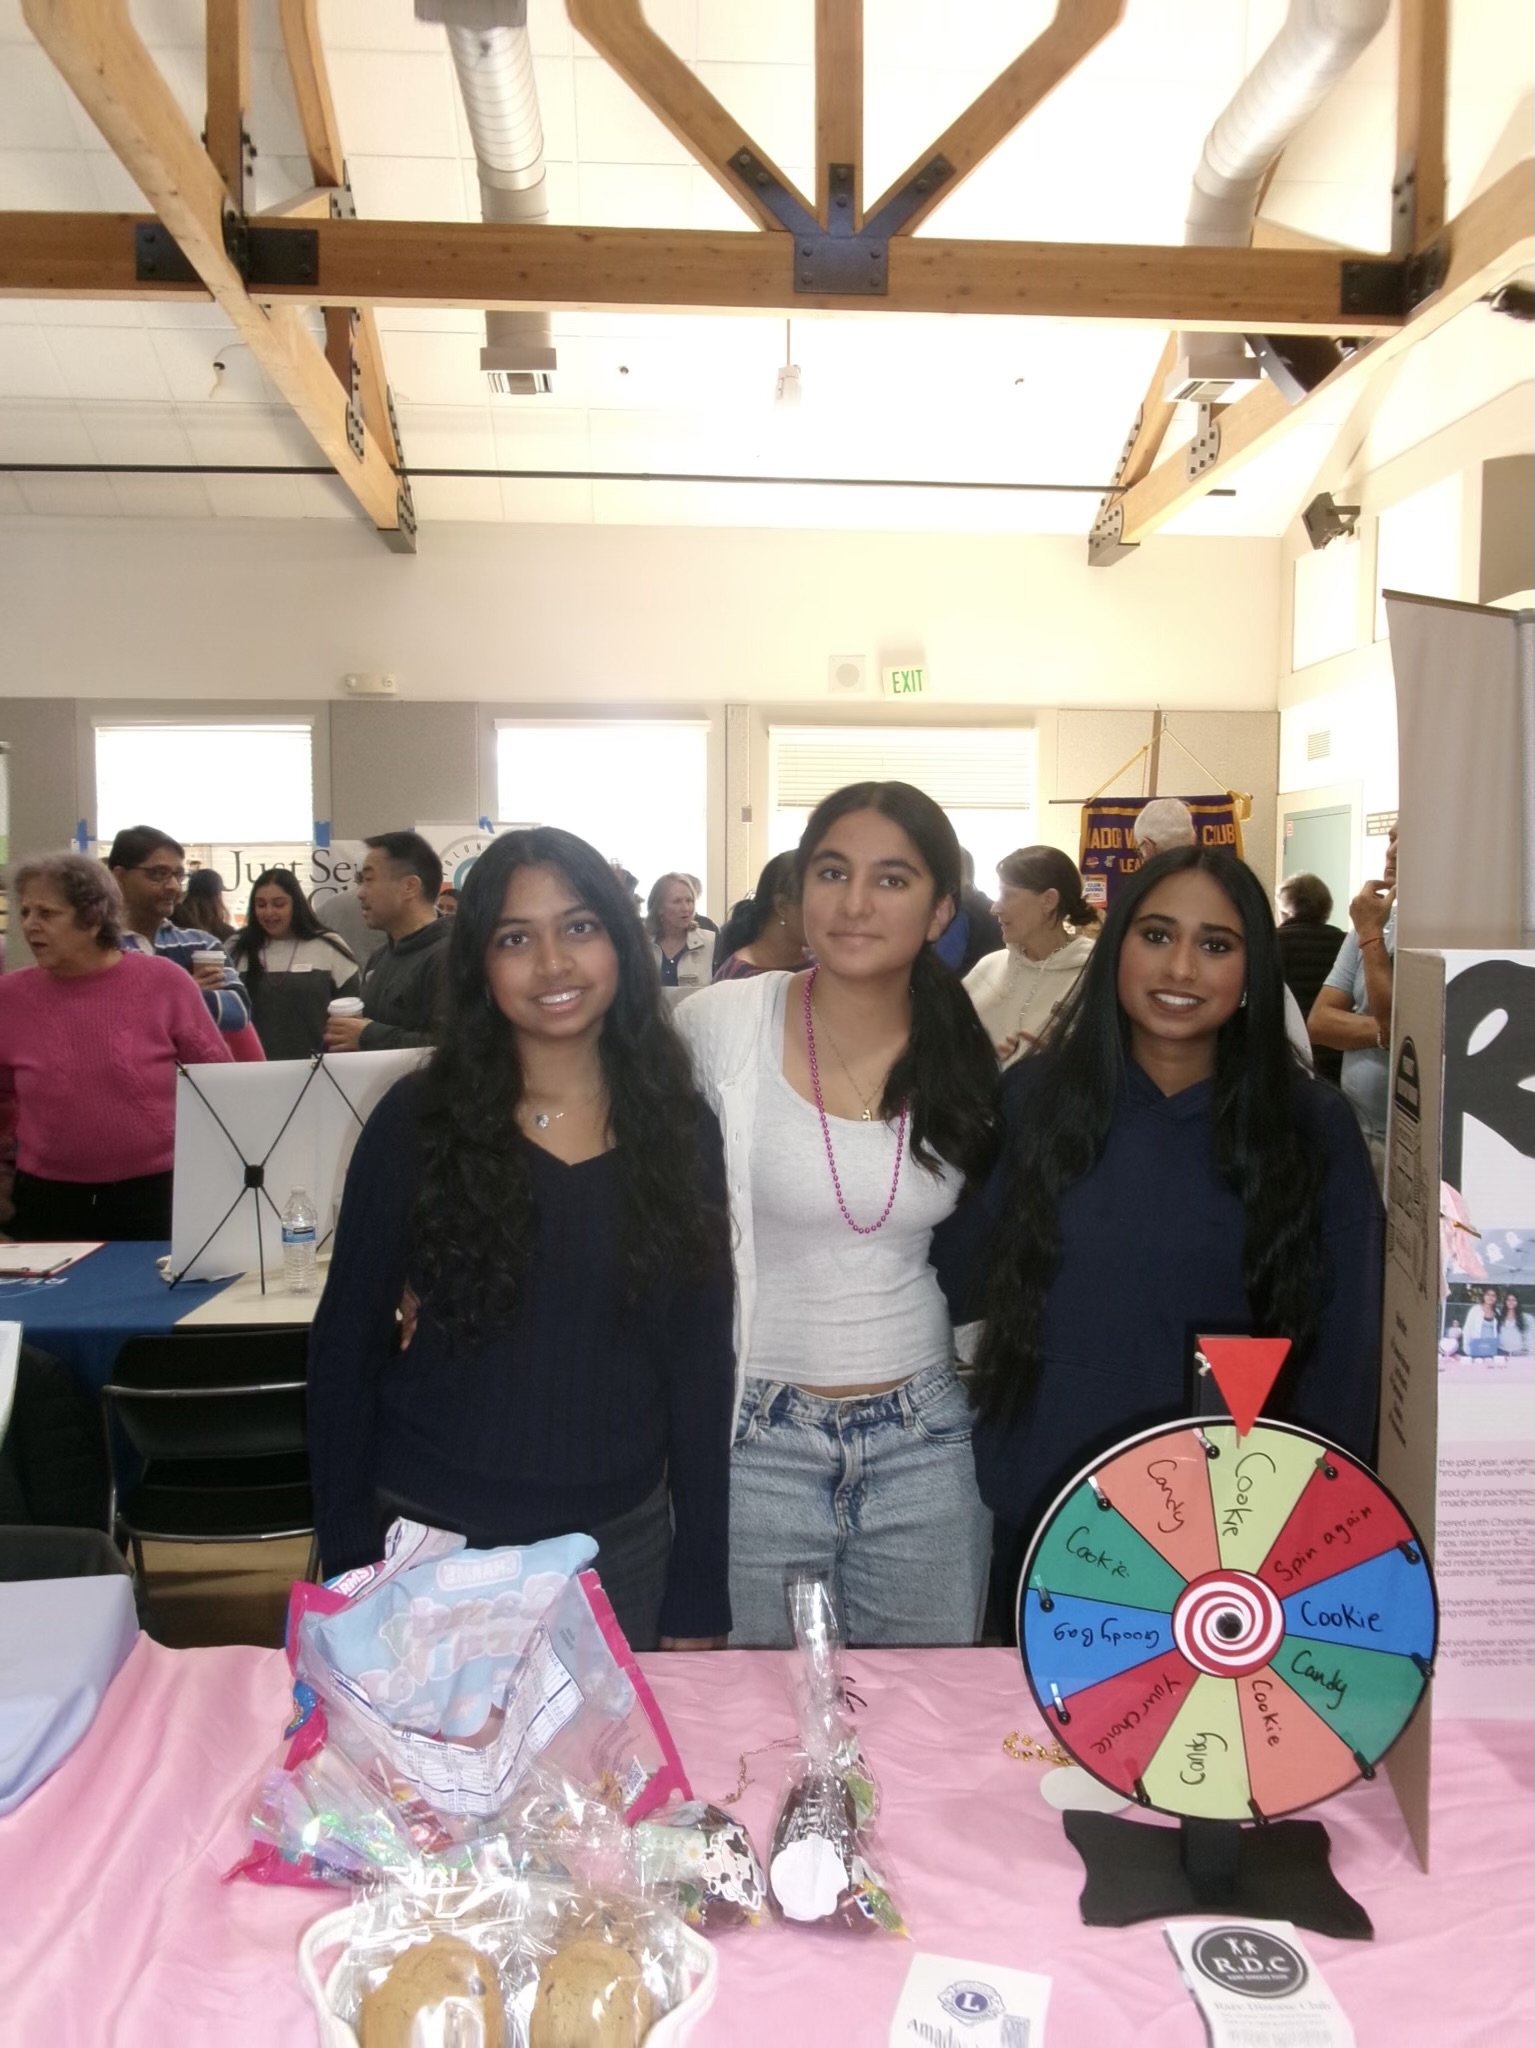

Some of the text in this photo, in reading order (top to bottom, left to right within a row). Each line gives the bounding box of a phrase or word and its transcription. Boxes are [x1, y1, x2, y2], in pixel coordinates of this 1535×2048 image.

[892, 669, 923, 694] EXIT
[1147, 1460, 1185, 1534] Candy
[1273, 1506, 1373, 1582] Spin again
[1054, 1618, 1159, 1648] Goody Bag
[1301, 1600, 1383, 1632] Cookie
[1291, 1650, 1348, 1710] Candy
[1252, 1680, 1282, 1747] Cookie
[1180, 1732, 1228, 1785] Candy
[1212, 1956, 1291, 1974] R.D.C
